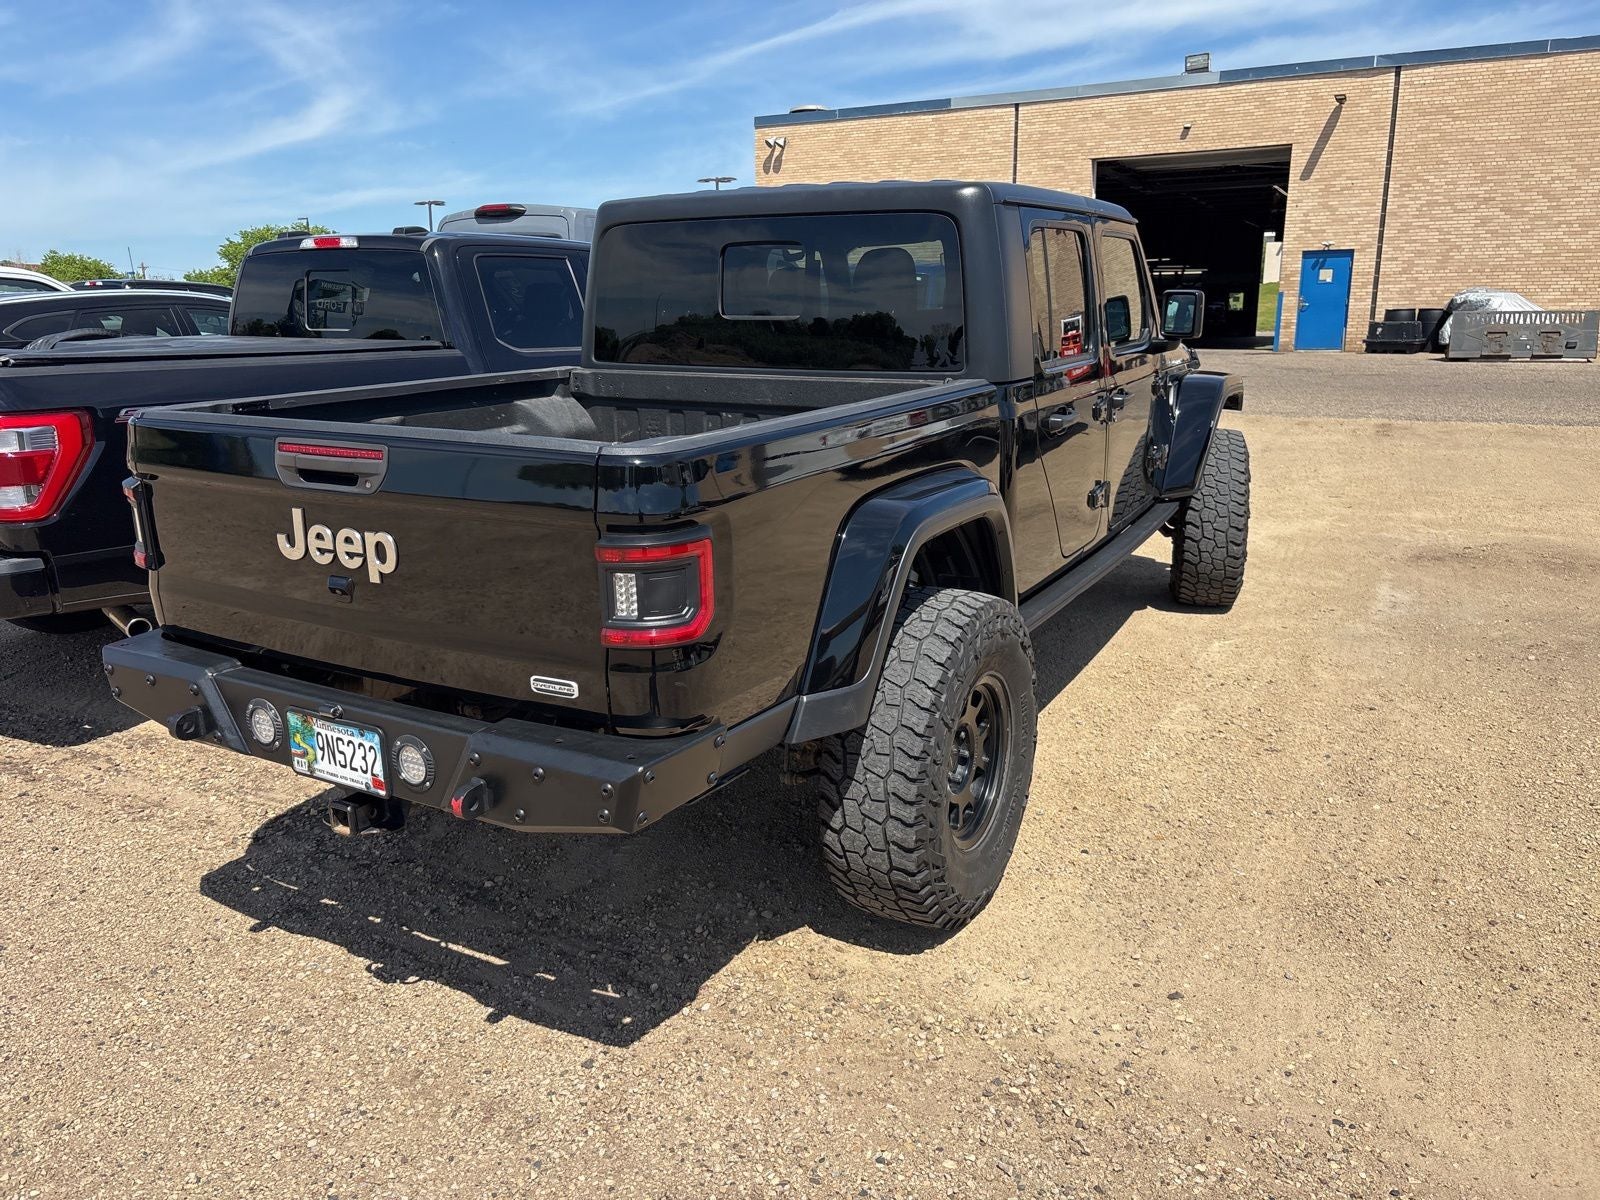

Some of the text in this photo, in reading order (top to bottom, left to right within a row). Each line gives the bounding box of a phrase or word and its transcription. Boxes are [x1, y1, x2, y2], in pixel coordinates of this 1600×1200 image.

[277, 507, 397, 584] Jeep
[532, 682, 575, 693] OVERLAND
[313, 718, 355, 737] Minnesota
[296, 759, 307, 770] MAY
[349, 777, 364, 785] TRAILS
